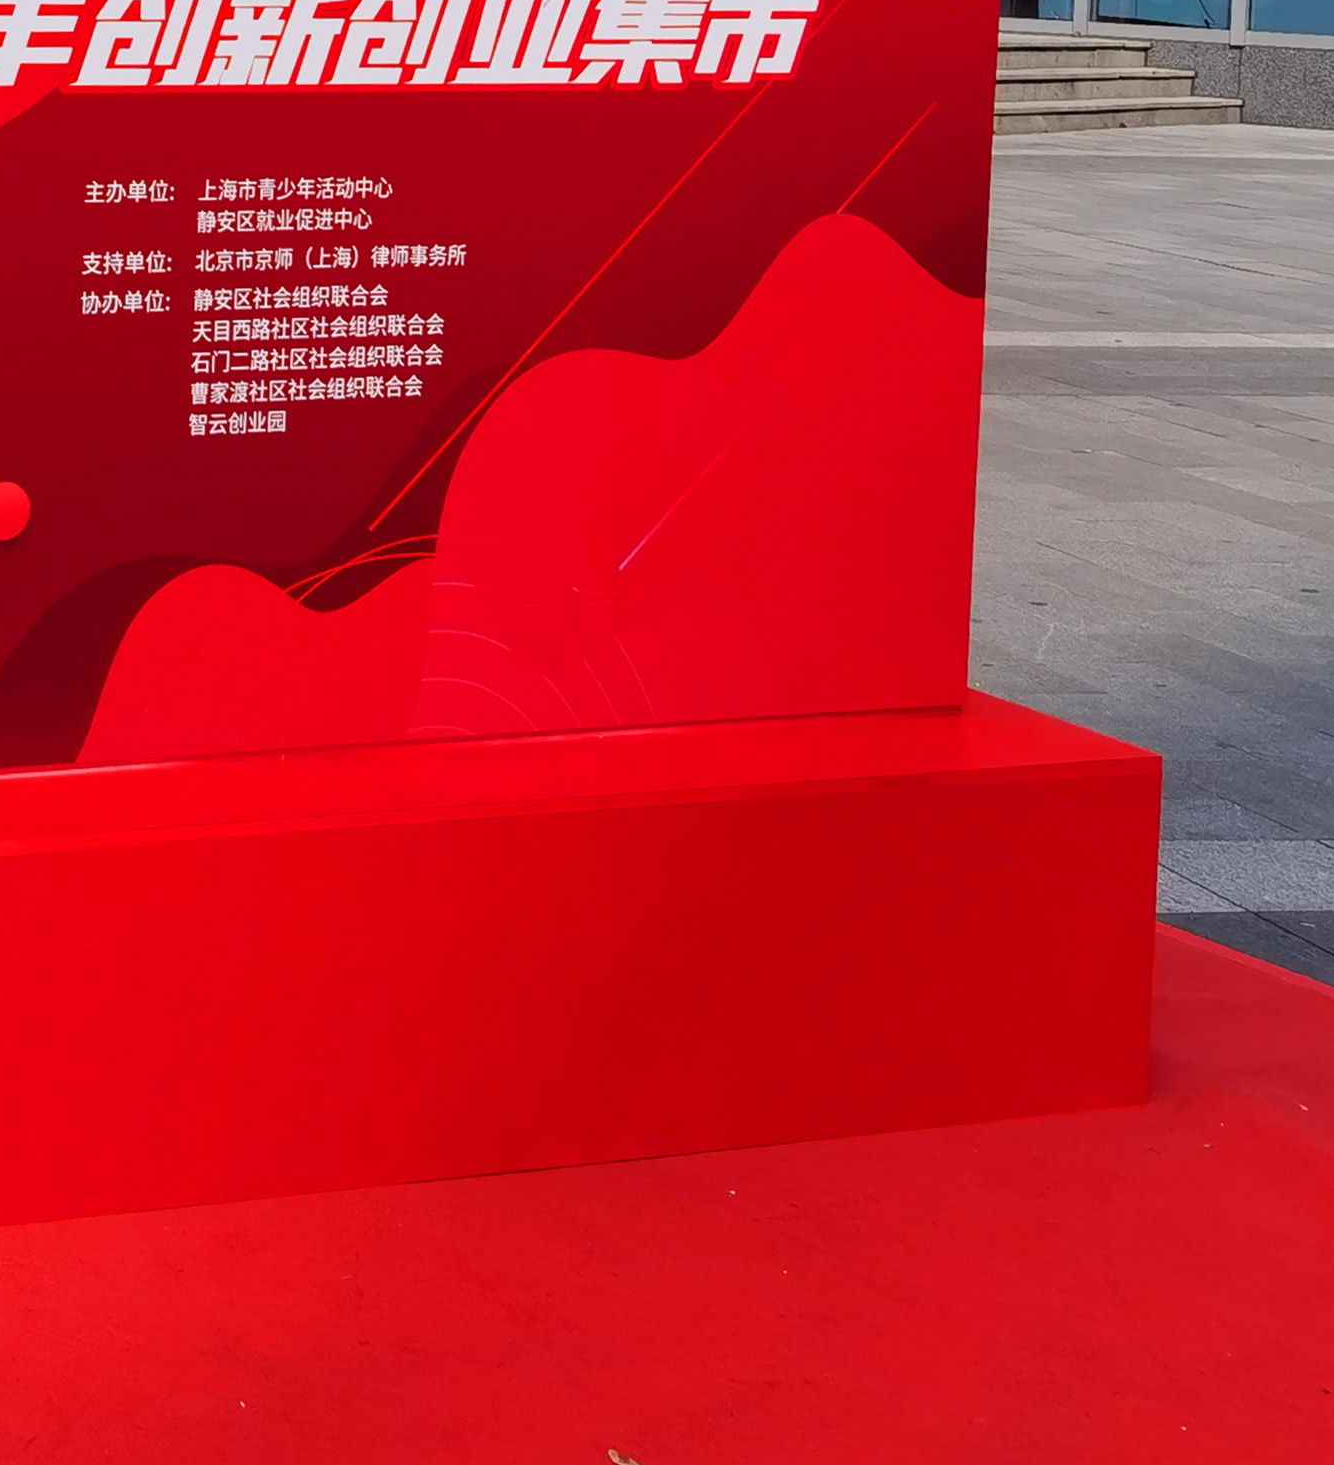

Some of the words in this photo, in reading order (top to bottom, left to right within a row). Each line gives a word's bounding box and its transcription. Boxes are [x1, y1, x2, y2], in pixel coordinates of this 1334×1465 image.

[197, 176, 393, 202] 上海市青少年活动中心
[197, 207, 373, 234] 静安区就业促进中心
[193, 283, 389, 312] 静安区社会组织联合会
[192, 312, 445, 343] 天目西路社区社会组织联合会
[190, 343, 444, 374] 石门二路社区社会组织联合会
[190, 374, 423, 405] 曹家渡社区社会组织联合会
[188, 410, 287, 436] 智云创业园
